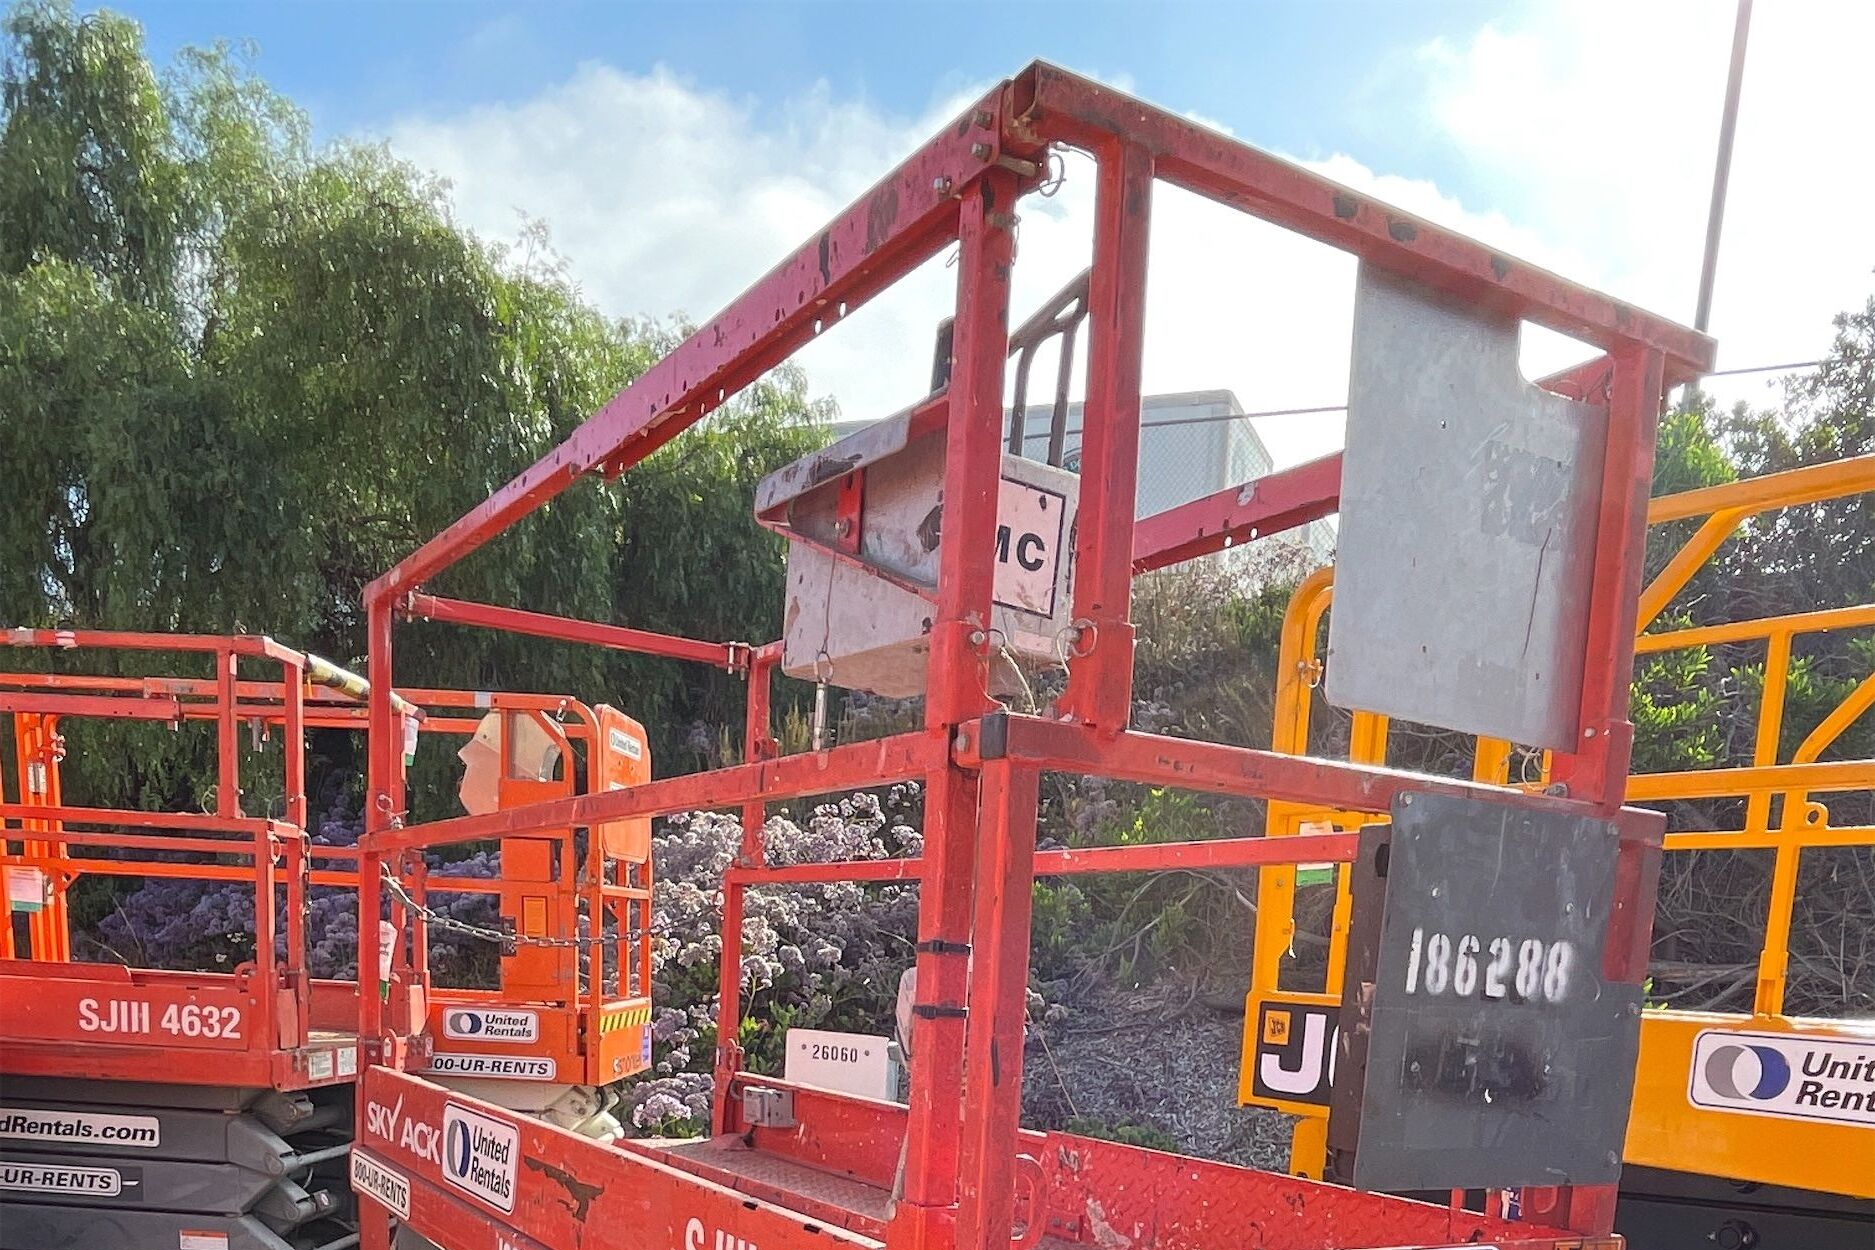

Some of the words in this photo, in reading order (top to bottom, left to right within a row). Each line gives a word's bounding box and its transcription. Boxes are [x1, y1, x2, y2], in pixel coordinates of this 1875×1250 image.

[1405, 926, 1574, 1001] 186288
[79, 998, 150, 1034] SJIII
[160, 1003, 241, 1039] 4632
[485, 1013, 528, 1027] United
[485, 1025, 532, 1038] Rentals
[430, 1057, 549, 1075] 00-UR-RENTS
[812, 1044, 858, 1063] 26060
[1260, 1012, 1340, 1095] J
[473, 1125, 511, 1165] United
[354, 1159, 407, 1209] 800-UR-RENTS
[470, 1156, 511, 1199] Rentals
